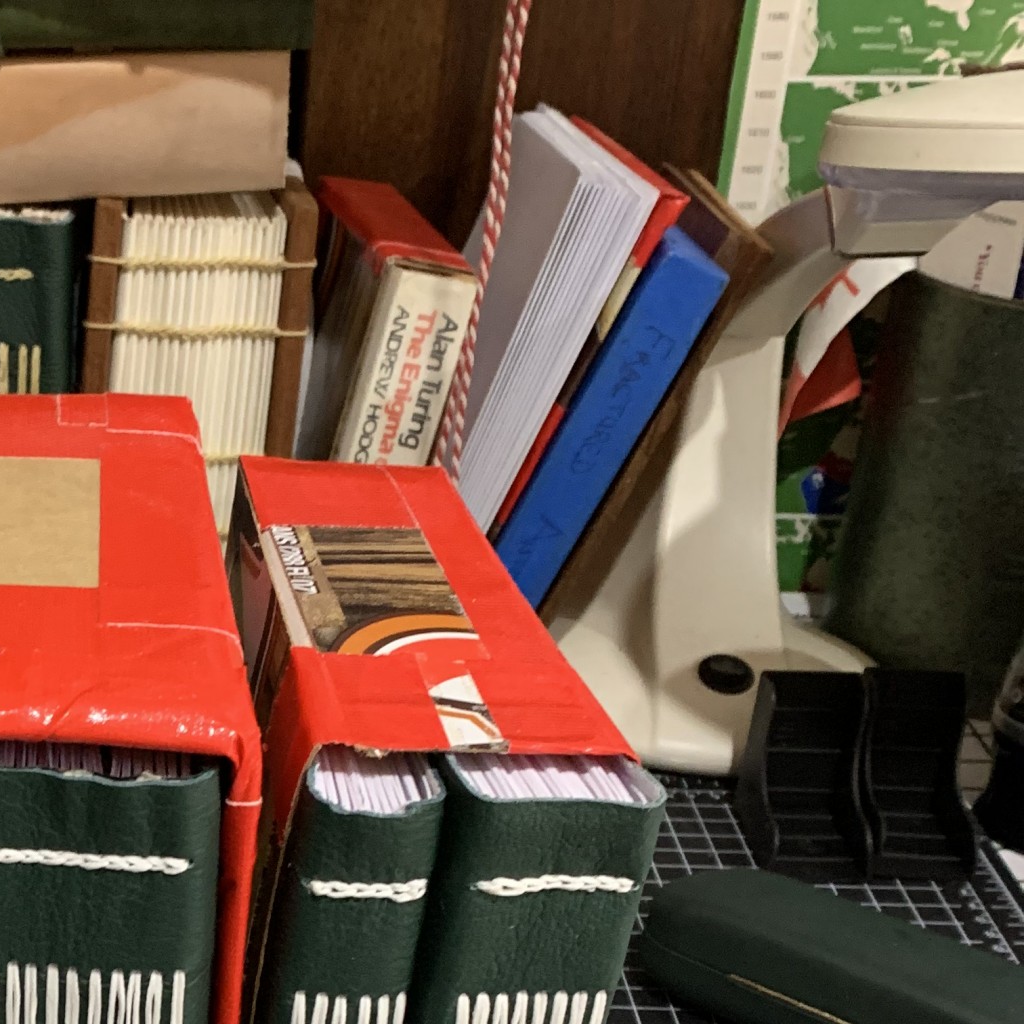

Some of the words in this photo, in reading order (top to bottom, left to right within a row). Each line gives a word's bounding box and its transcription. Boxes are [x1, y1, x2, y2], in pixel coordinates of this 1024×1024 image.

[373, 304, 410, 400] ANDREW
[406, 309, 438, 359] The
[426, 311, 459, 372] Alan
[354, 403, 383, 464] HODG
[378, 362, 422, 455] Enigma
[398, 380, 443, 451] Turing
